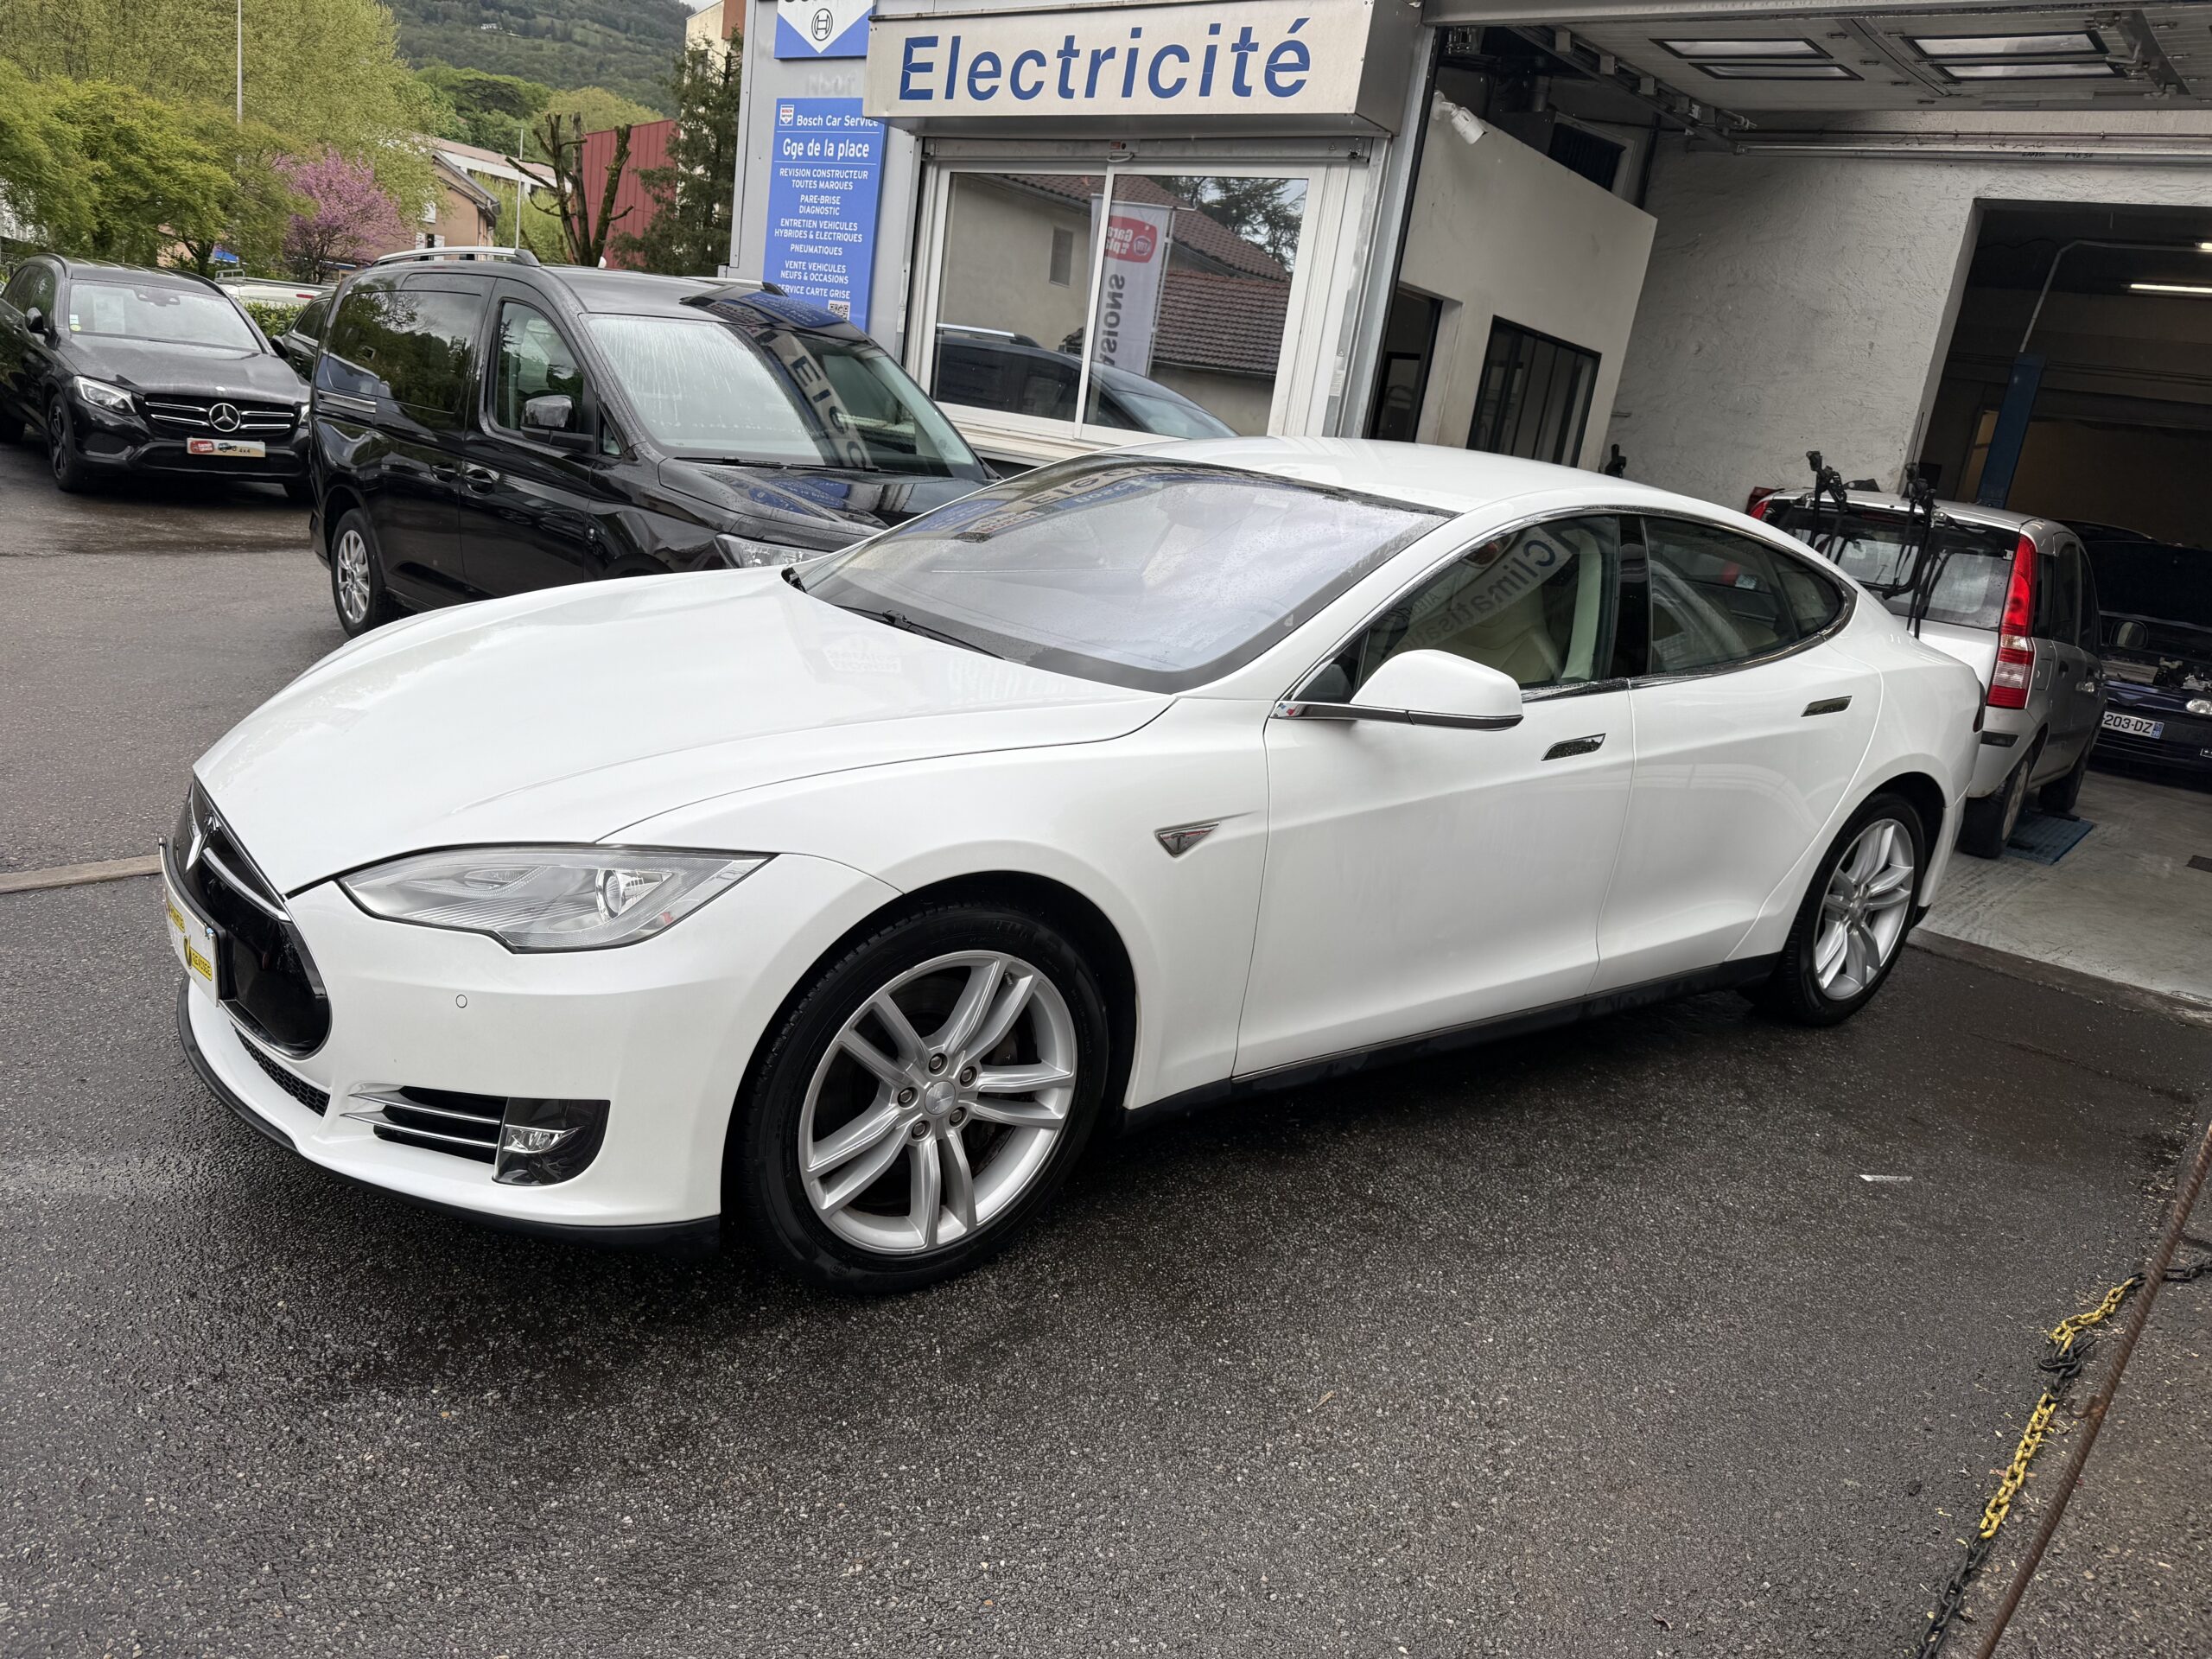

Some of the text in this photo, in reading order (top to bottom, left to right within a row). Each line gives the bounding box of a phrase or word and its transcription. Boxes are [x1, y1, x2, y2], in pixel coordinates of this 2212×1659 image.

[899, 17, 1311, 101] Electricité
[797, 115, 879, 127] Bosch Car Service
[783, 138, 870, 161] Gge de la place
[779, 168, 868, 180] REVISION CONSTRUCTEUR
[791, 179, 853, 191] TOUTES MARQUES
[800, 194, 842, 205] PARE-BRISE
[798, 205, 840, 216] DIAGNOSTIC
[780, 218, 858, 232] ENTRETIEN VEHICULES
[774, 228, 862, 243] HYBRIDES & ELECTRIQUES
[790, 243, 843, 256] PNEUMATIQUES
[785, 260, 847, 274] VENTE VEHICULES
[780, 270, 802, 281] NEUFS
[810, 273, 849, 285] OCCASIONS
[805, 286, 828, 297] CARTE
[830, 289, 851, 300] GRISE
